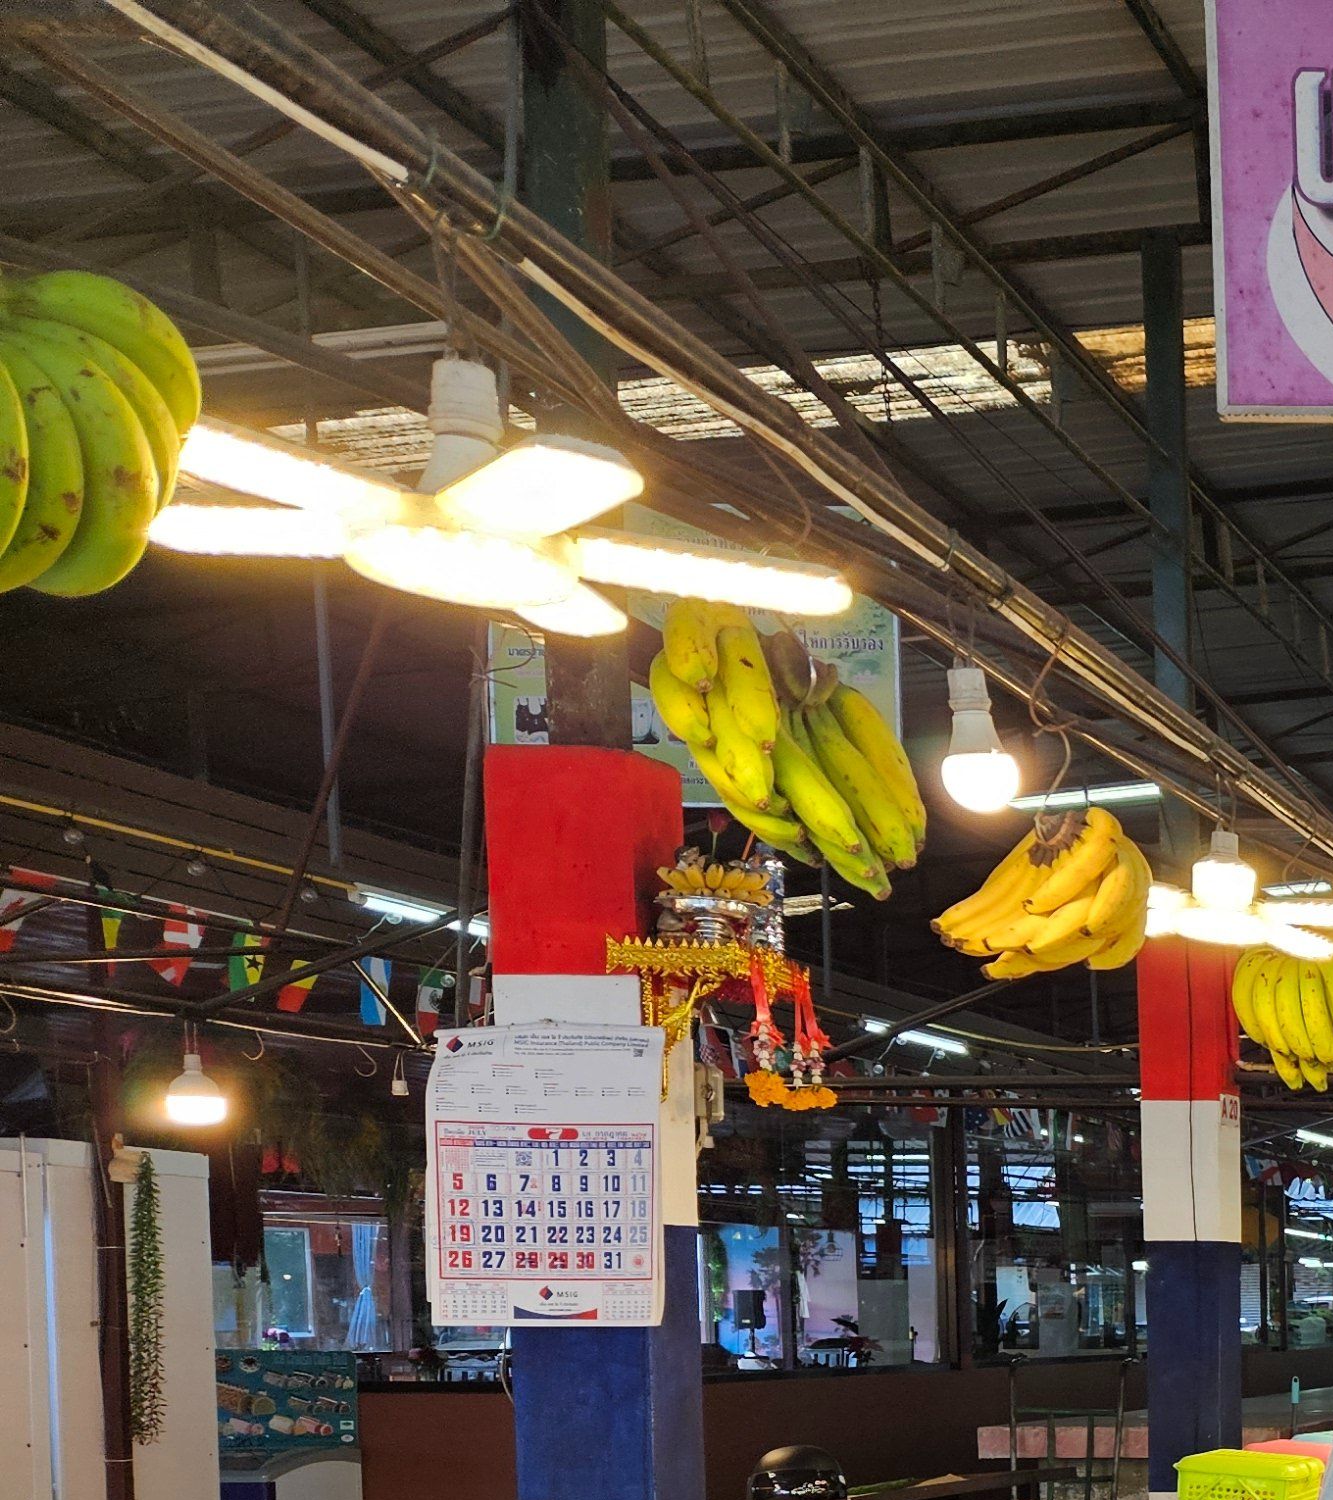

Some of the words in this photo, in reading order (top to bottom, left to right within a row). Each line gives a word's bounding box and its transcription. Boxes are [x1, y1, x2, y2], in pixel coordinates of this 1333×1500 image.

[467, 1038, 495, 1049] MSIG
[552, 1150, 559, 1166] 1
[579, 1150, 588, 1166] 2
[607, 1150, 616, 1166] 3
[452, 1173, 463, 1190] 5
[486, 1174, 497, 1191] 6
[520, 1174, 530, 1192] 7
[552, 1175, 561, 1192] 8
[579, 1175, 588, 1192] 9
[603, 1175, 620, 1192] 10
[631, 1175, 646, 1192] 11
[448, 1199, 470, 1217] 12
[481, 1200, 503, 1217] 13
[515, 1200, 536, 1218] 14
[547, 1200, 567, 1218] 15
[576, 1200, 594, 1218] 16
[603, 1200, 620, 1218] 17
[631, 1200, 647, 1218] 18
[449, 1224, 471, 1242] 19
[481, 1225, 505, 1243] 20
[516, 1226, 537, 1244] 21
[547, 1226, 568, 1244] 22
[576, 1226, 595, 1244] 23
[603, 1226, 622, 1244] 24
[629, 1226, 648, 1244] 25
[448, 1250, 473, 1268] 26
[482, 1251, 506, 1268] 27
[515, 1251, 539, 1269] 28
[548, 1251, 569, 1269] 29
[576, 1251, 595, 1269] 30
[603, 1251, 622, 1269] 31
[556, 1290, 578, 1298] MSIG
